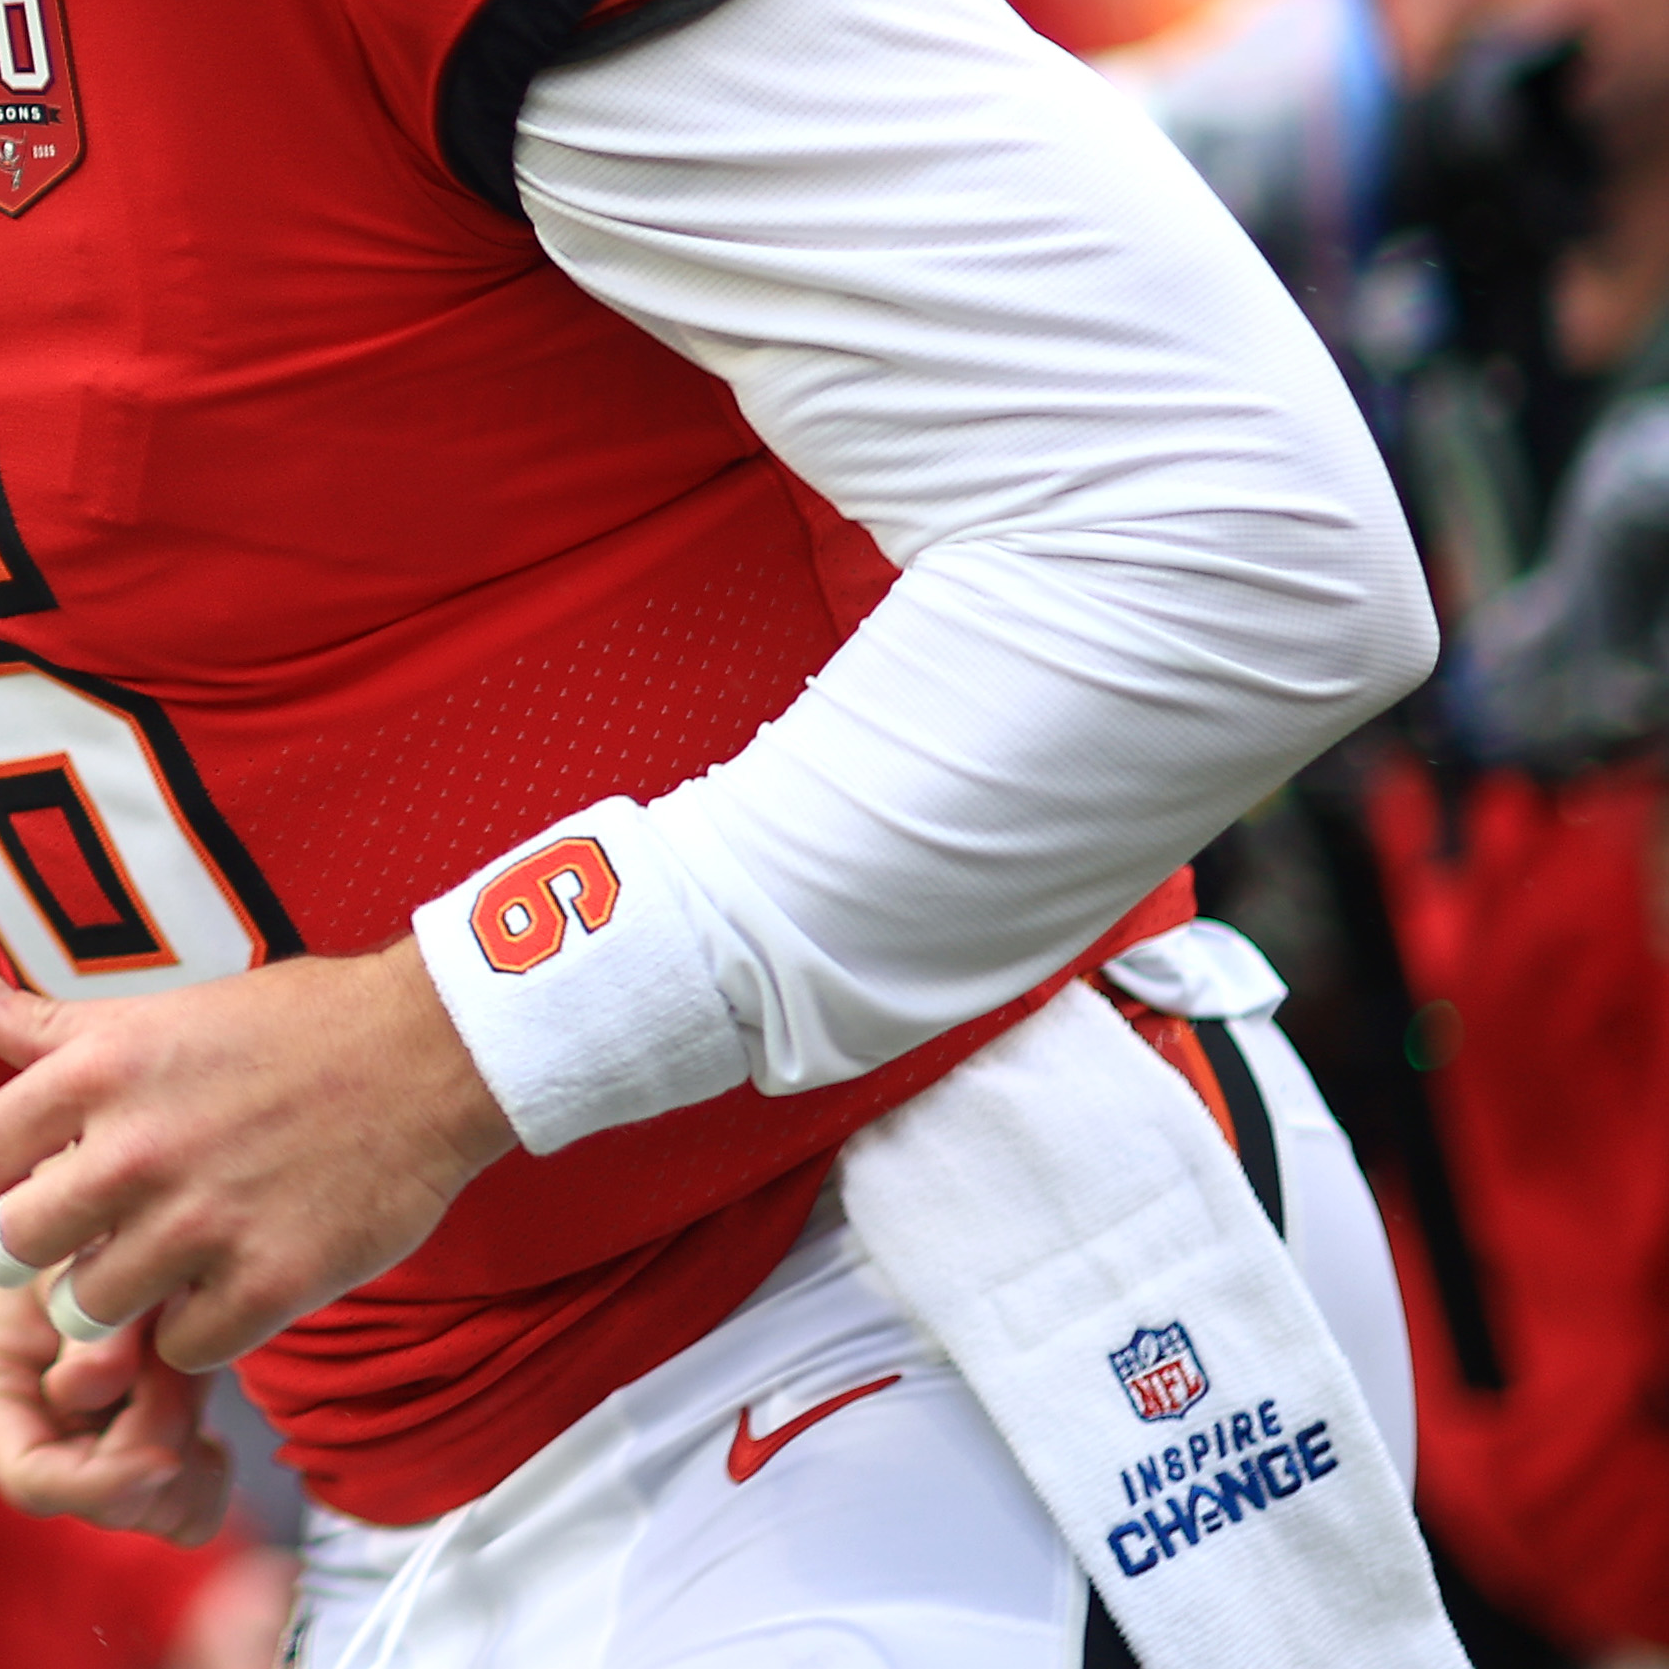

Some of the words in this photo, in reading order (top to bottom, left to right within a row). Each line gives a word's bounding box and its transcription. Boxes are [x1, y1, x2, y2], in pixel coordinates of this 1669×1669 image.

[469, 836, 621, 974] 6
[1127, 1358, 1204, 1418] NFL
[1106, 1419, 1340, 1578] CHANGE
